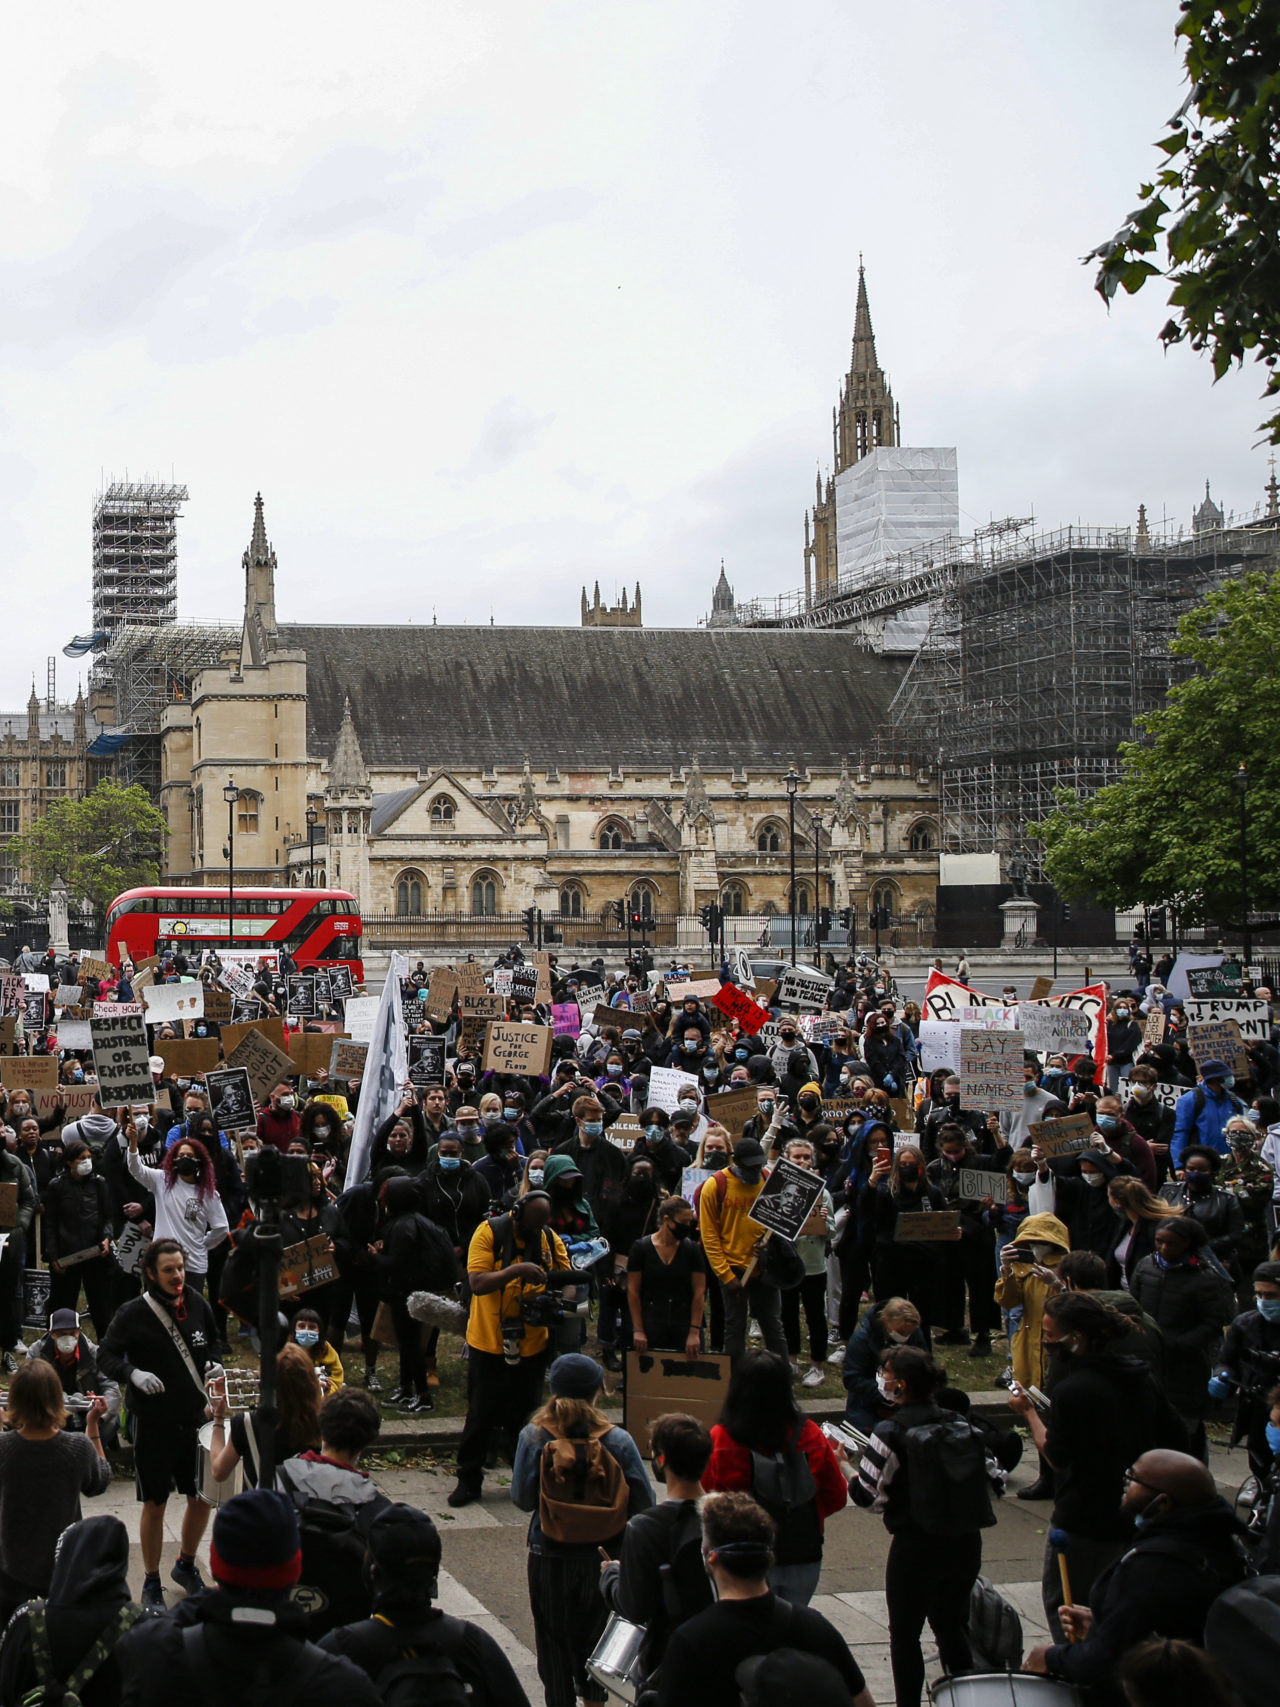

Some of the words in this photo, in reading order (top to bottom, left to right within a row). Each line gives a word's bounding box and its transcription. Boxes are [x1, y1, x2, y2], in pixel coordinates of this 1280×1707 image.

[459, 964, 480, 974] WHITE
[512, 984, 536, 993] EXPECT
[783, 976, 795, 987] NO
[795, 978, 831, 994] JUSTICE
[576, 989, 592, 1000] BLACK
[580, 994, 604, 1006] MATTER
[784, 987, 798, 998] NO
[798, 989, 827, 1004] PEACE
[465, 996, 498, 1008] BLACK
[559, 1004, 568, 1013] I
[1187, 1001, 1265, 1012] TRUMP
[94, 1003, 118, 1013] Check
[121, 1004, 142, 1015] your
[964, 1008, 1011, 1021] BLACK
[1190, 1012, 1204, 1022] IS
[1209, 1012, 1219, 1021] A
[91, 1016, 142, 1032] RESPECT
[1191, 1025, 1198, 1035] I
[1201, 1024, 1228, 1032] WANT
[492, 1026, 538, 1043] JUSTICE
[93, 1034, 147, 1050] EXISTENCE
[970, 1037, 1008, 1054] SAY
[1193, 1041, 1206, 1049] MY
[112, 1050, 132, 1063] OR
[493, 1046, 529, 1059] GEORGE
[98, 1062, 150, 1078] EXPECT
[257, 1055, 283, 1087] NOT
[504, 1060, 527, 1070] FLOYD
[966, 1061, 1012, 1075] THEIR
[100, 1083, 155, 1101] RESISTANCE
[966, 1084, 1014, 1097] NAMES
[40, 1095, 59, 1109] NO
[610, 1122, 643, 1132] SILENCE
[961, 1169, 1005, 1200] BLM
